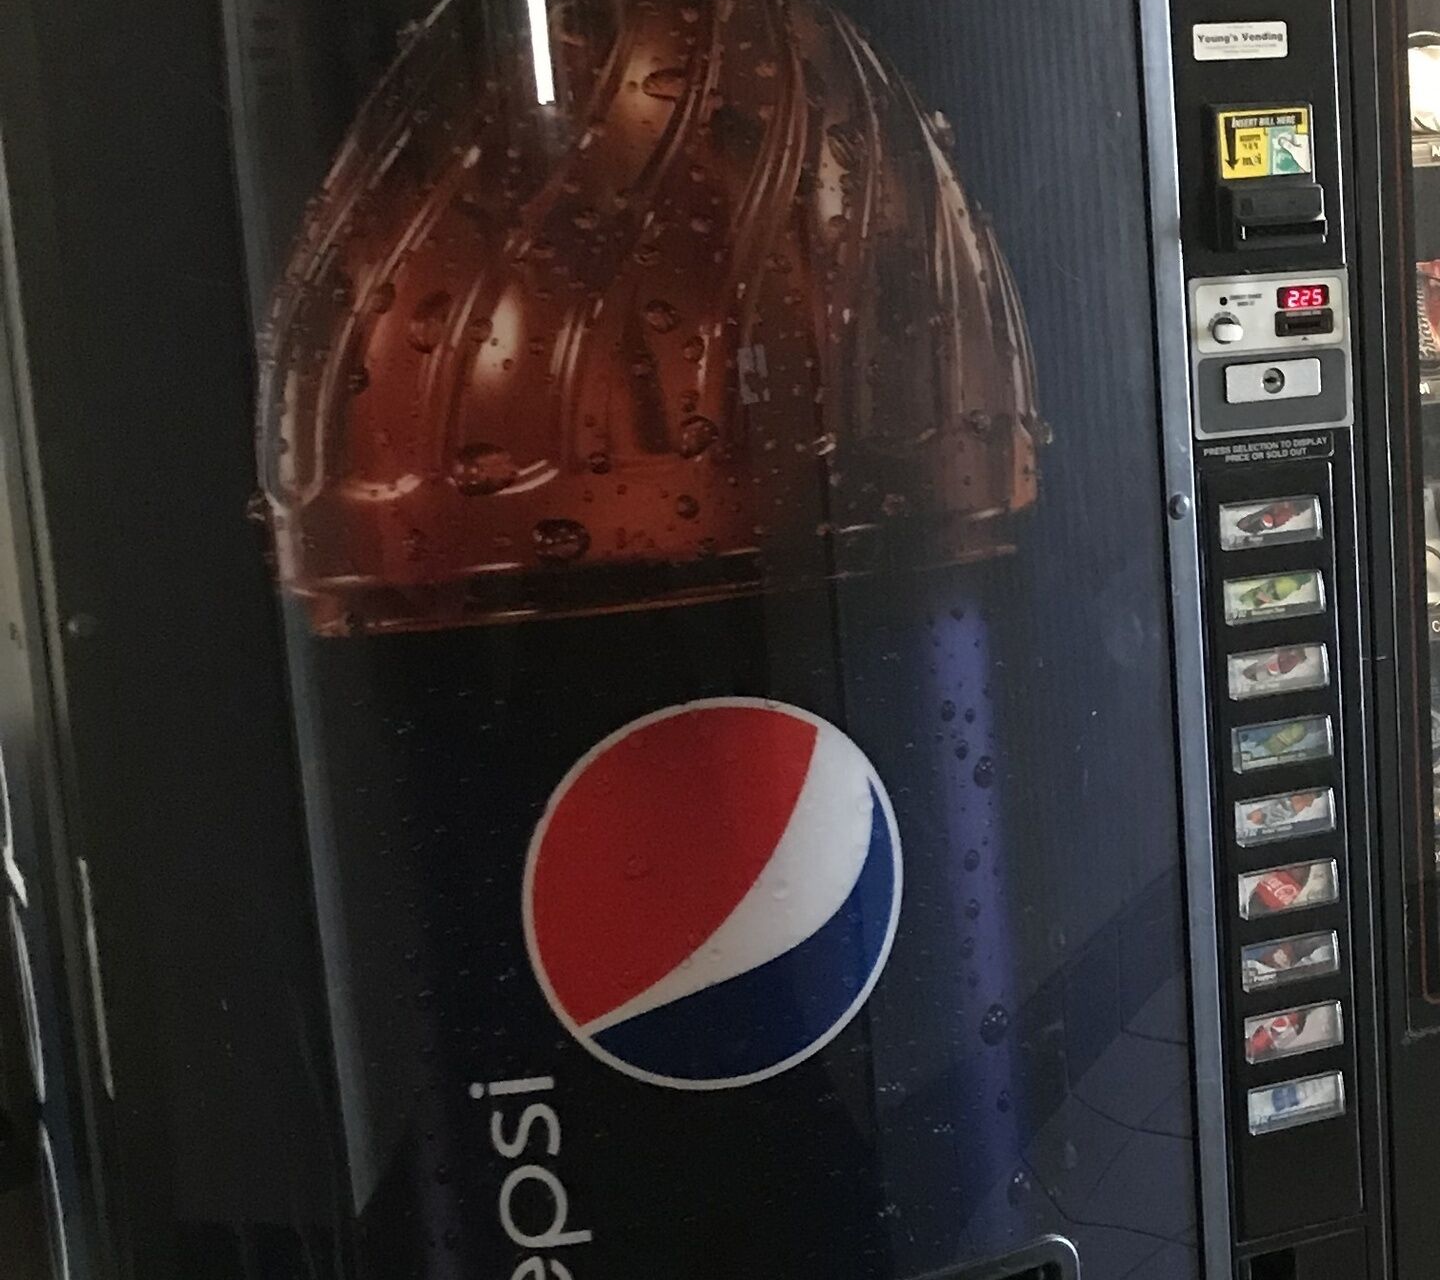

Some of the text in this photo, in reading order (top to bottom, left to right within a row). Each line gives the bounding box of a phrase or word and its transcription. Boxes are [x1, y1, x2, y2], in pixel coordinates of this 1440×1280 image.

[1197, 31, 1283, 44] Young's Vending
[1231, 115, 1296, 128] INSERT BILL HERE
[1203, 436, 1328, 457] PRESS SELECTION TO DISPLAY
[1225, 447, 1307, 463] PRICE OR SOLD OUT
